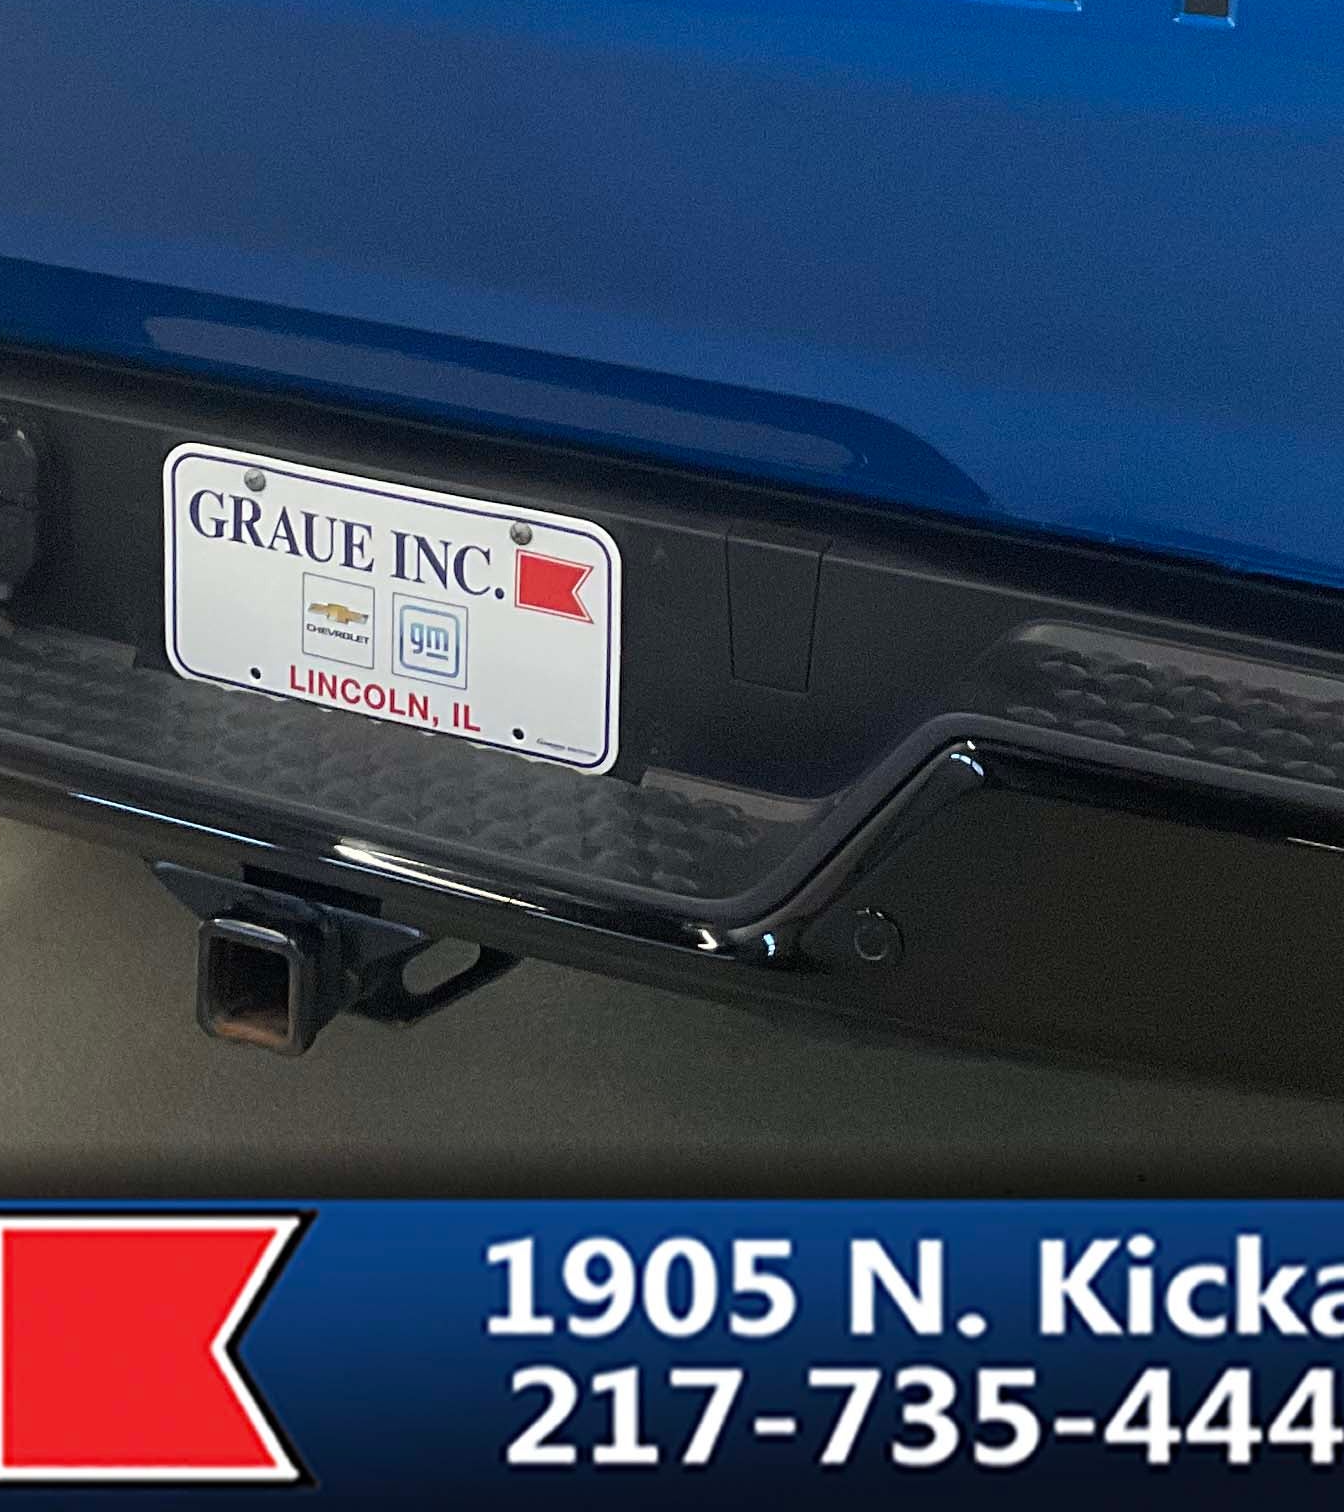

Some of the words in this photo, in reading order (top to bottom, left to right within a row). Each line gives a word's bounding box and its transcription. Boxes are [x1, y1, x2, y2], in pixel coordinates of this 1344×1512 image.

[189, 489, 374, 573] GRAUE
[390, 530, 506, 600] INC.
[306, 623, 369, 645] CHEVROLET
[410, 620, 450, 654] gm
[289, 664, 439, 728] LINCOLN,
[453, 701, 481, 733] IL
